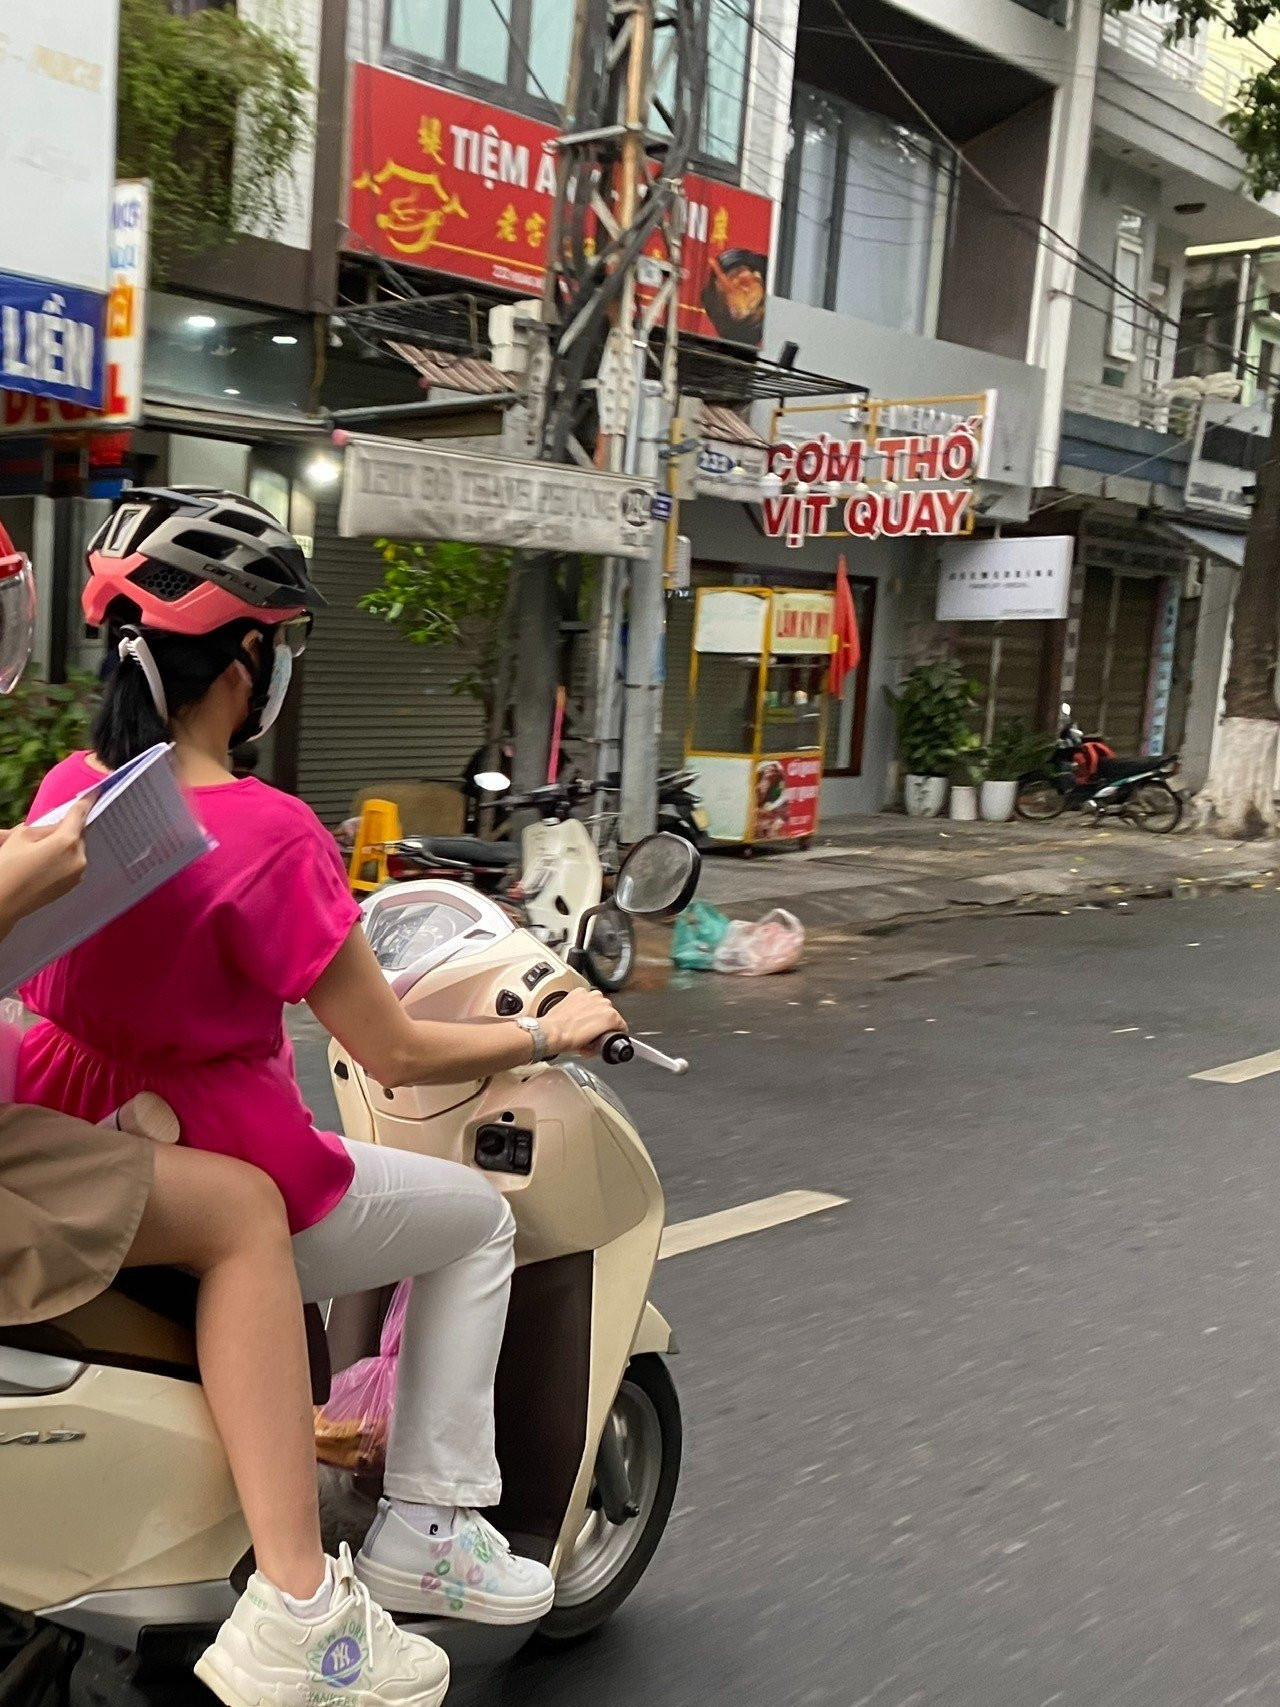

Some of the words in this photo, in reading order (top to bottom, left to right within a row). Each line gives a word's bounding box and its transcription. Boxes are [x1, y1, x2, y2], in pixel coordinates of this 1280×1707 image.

[449, 124, 531, 190] TIỆM
[1, 292, 96, 392] LIỀN
[768, 432, 865, 485] CƠM
[762, 491, 834, 548] VỊT
[843, 487, 972, 541] QUAY
